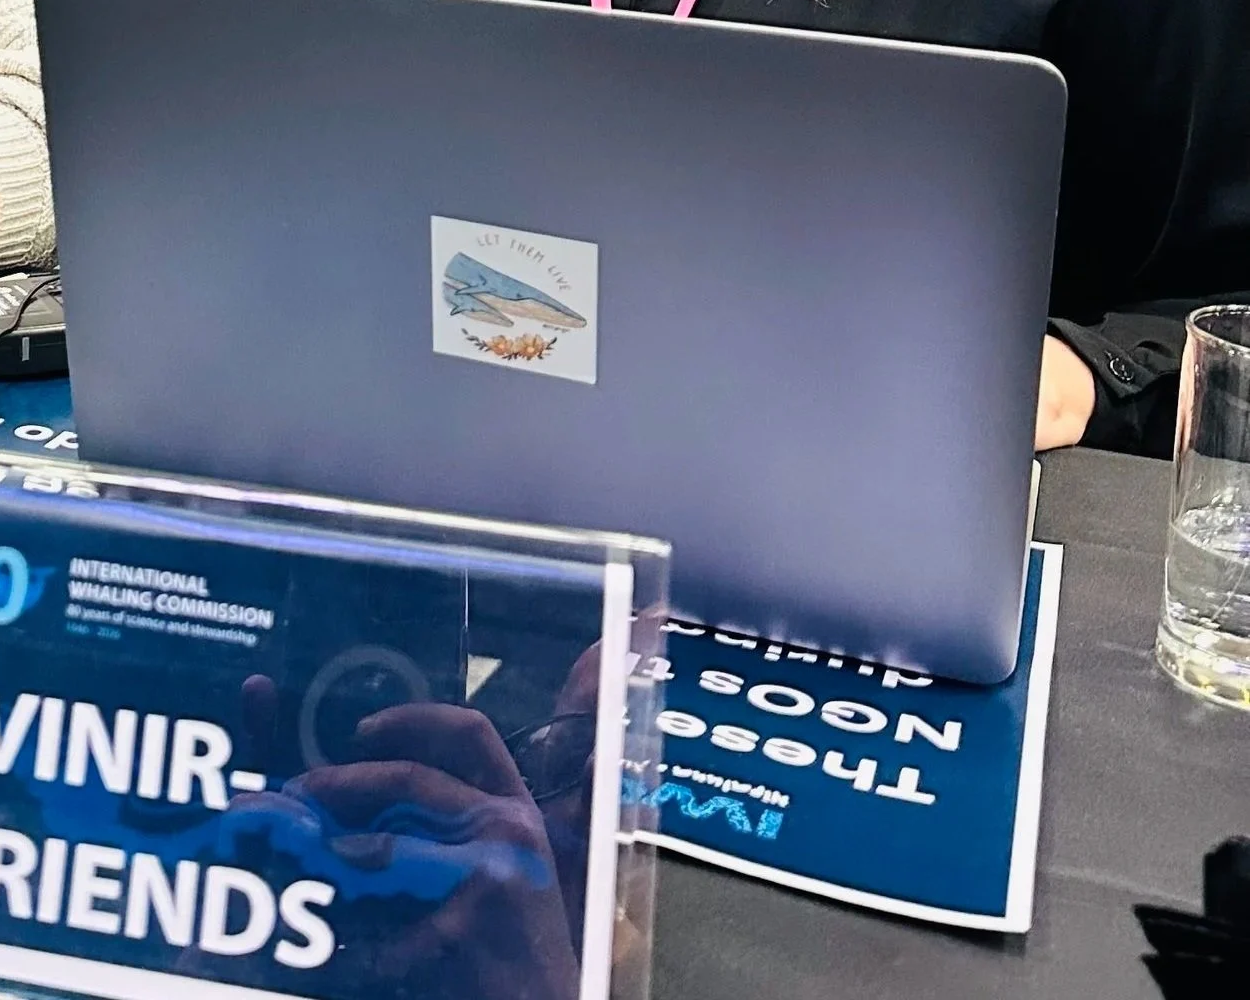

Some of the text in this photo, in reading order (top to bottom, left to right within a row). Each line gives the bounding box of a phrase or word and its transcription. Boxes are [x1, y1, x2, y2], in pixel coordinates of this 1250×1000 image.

[477, 234, 572, 292] LET THEM LIVE
[69, 557, 209, 597] INTERNATIONAL
[68, 580, 275, 630] WHALING COMMISSION
[81, 608, 111, 623] years
[112, 610, 126, 624] of
[125, 613, 165, 630] science
[166, 620, 189, 635] and
[190, 624, 258, 648] stewardship
[699, 669, 962, 752] NGOs
[655, 710, 936, 805] These
